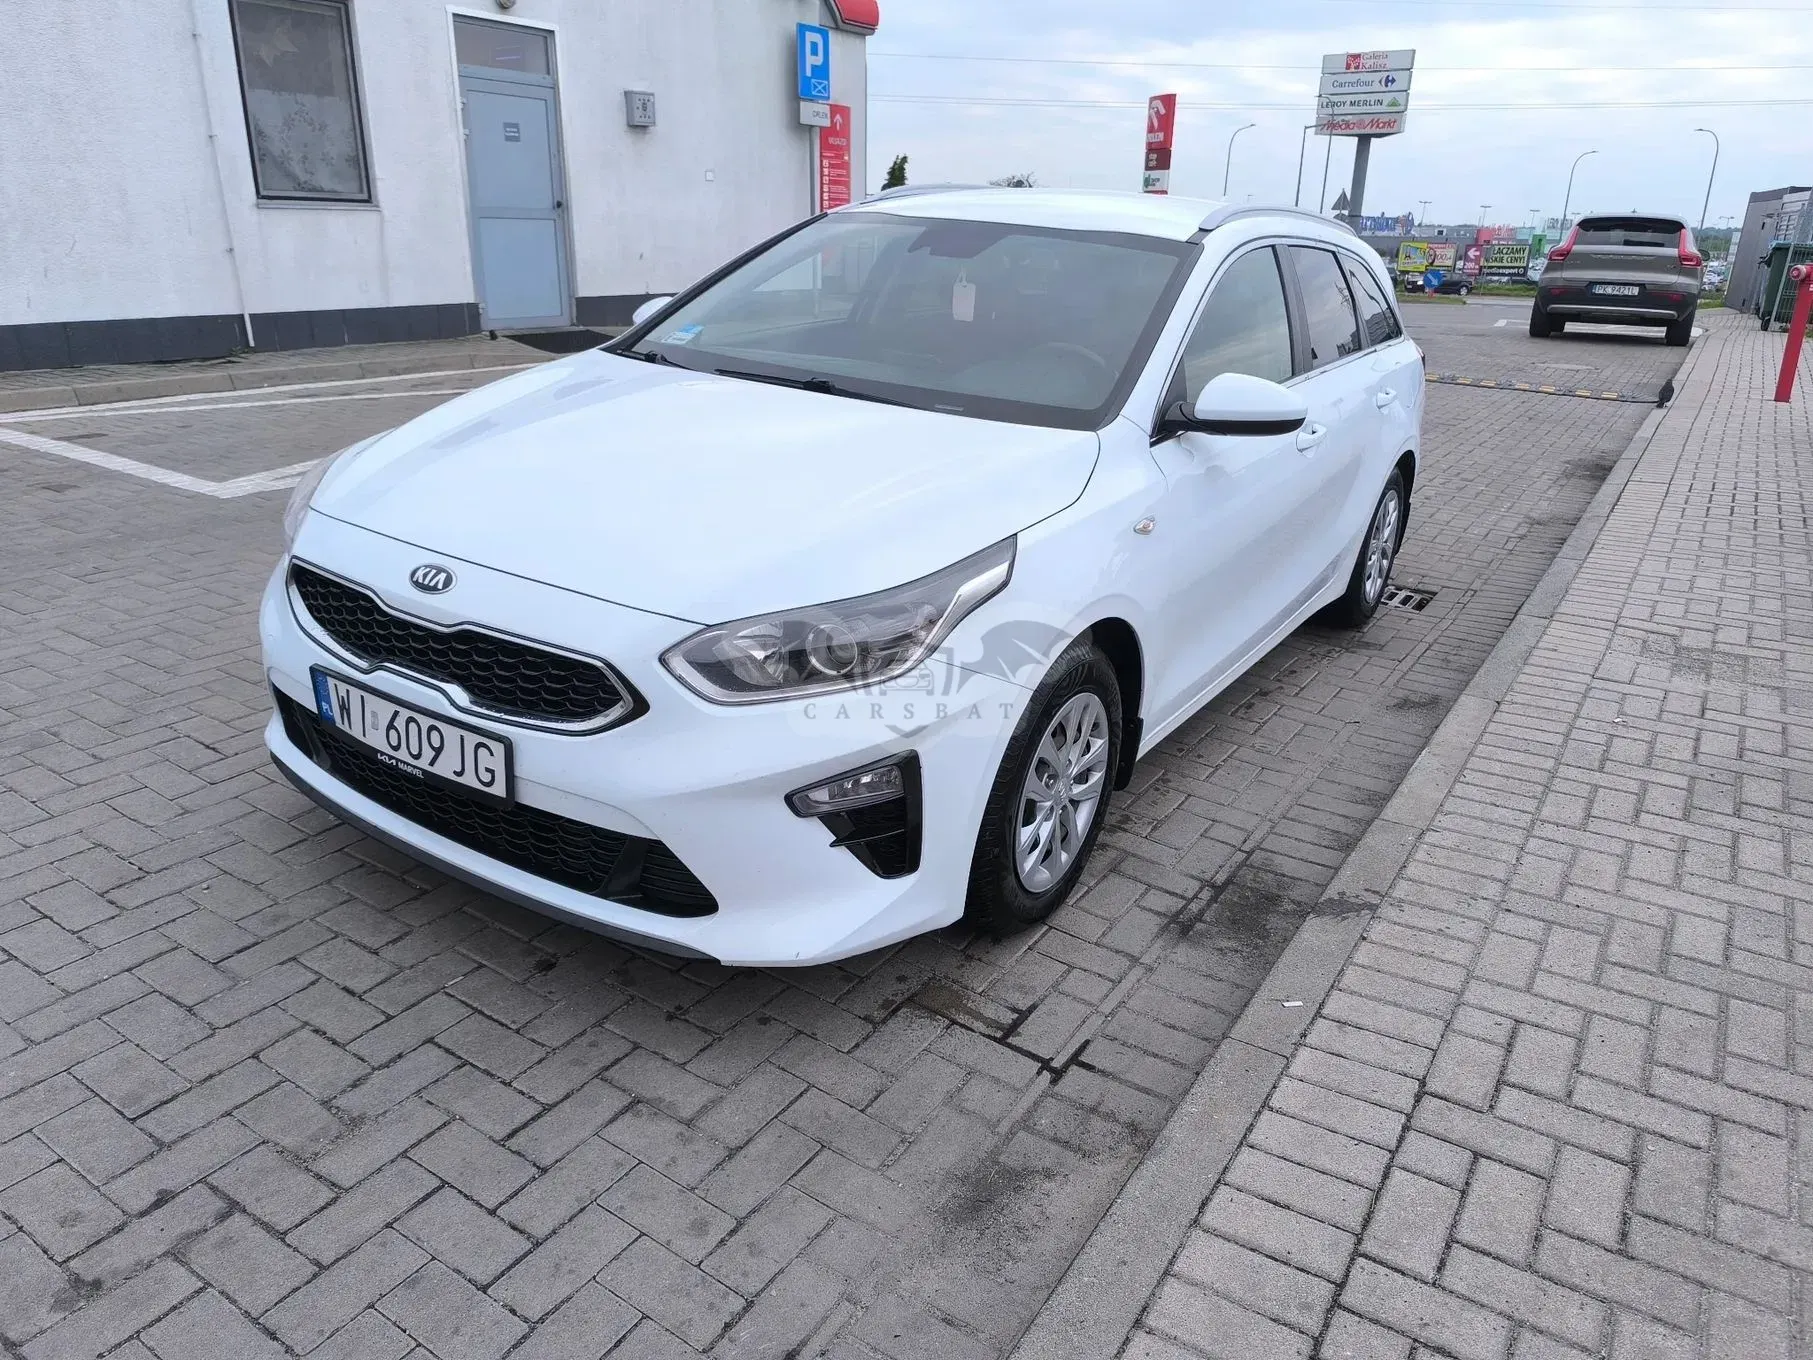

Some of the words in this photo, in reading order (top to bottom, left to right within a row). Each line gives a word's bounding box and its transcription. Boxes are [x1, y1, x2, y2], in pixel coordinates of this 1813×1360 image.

[805, 31, 824, 77] P
[1362, 52, 1388, 60] Galeria
[1361, 62, 1387, 70] Kalisz
[1332, 78, 1374, 88] Carrefour
[1321, 100, 1347, 109] LEROY
[1349, 99, 1384, 107] MERLIN
[1363, 118, 1397, 130] Markt
[412, 566, 447, 590] KIA
[322, 702, 333, 716] PL
[334, 682, 367, 738] WI
[398, 761, 424, 778] MARVEL
